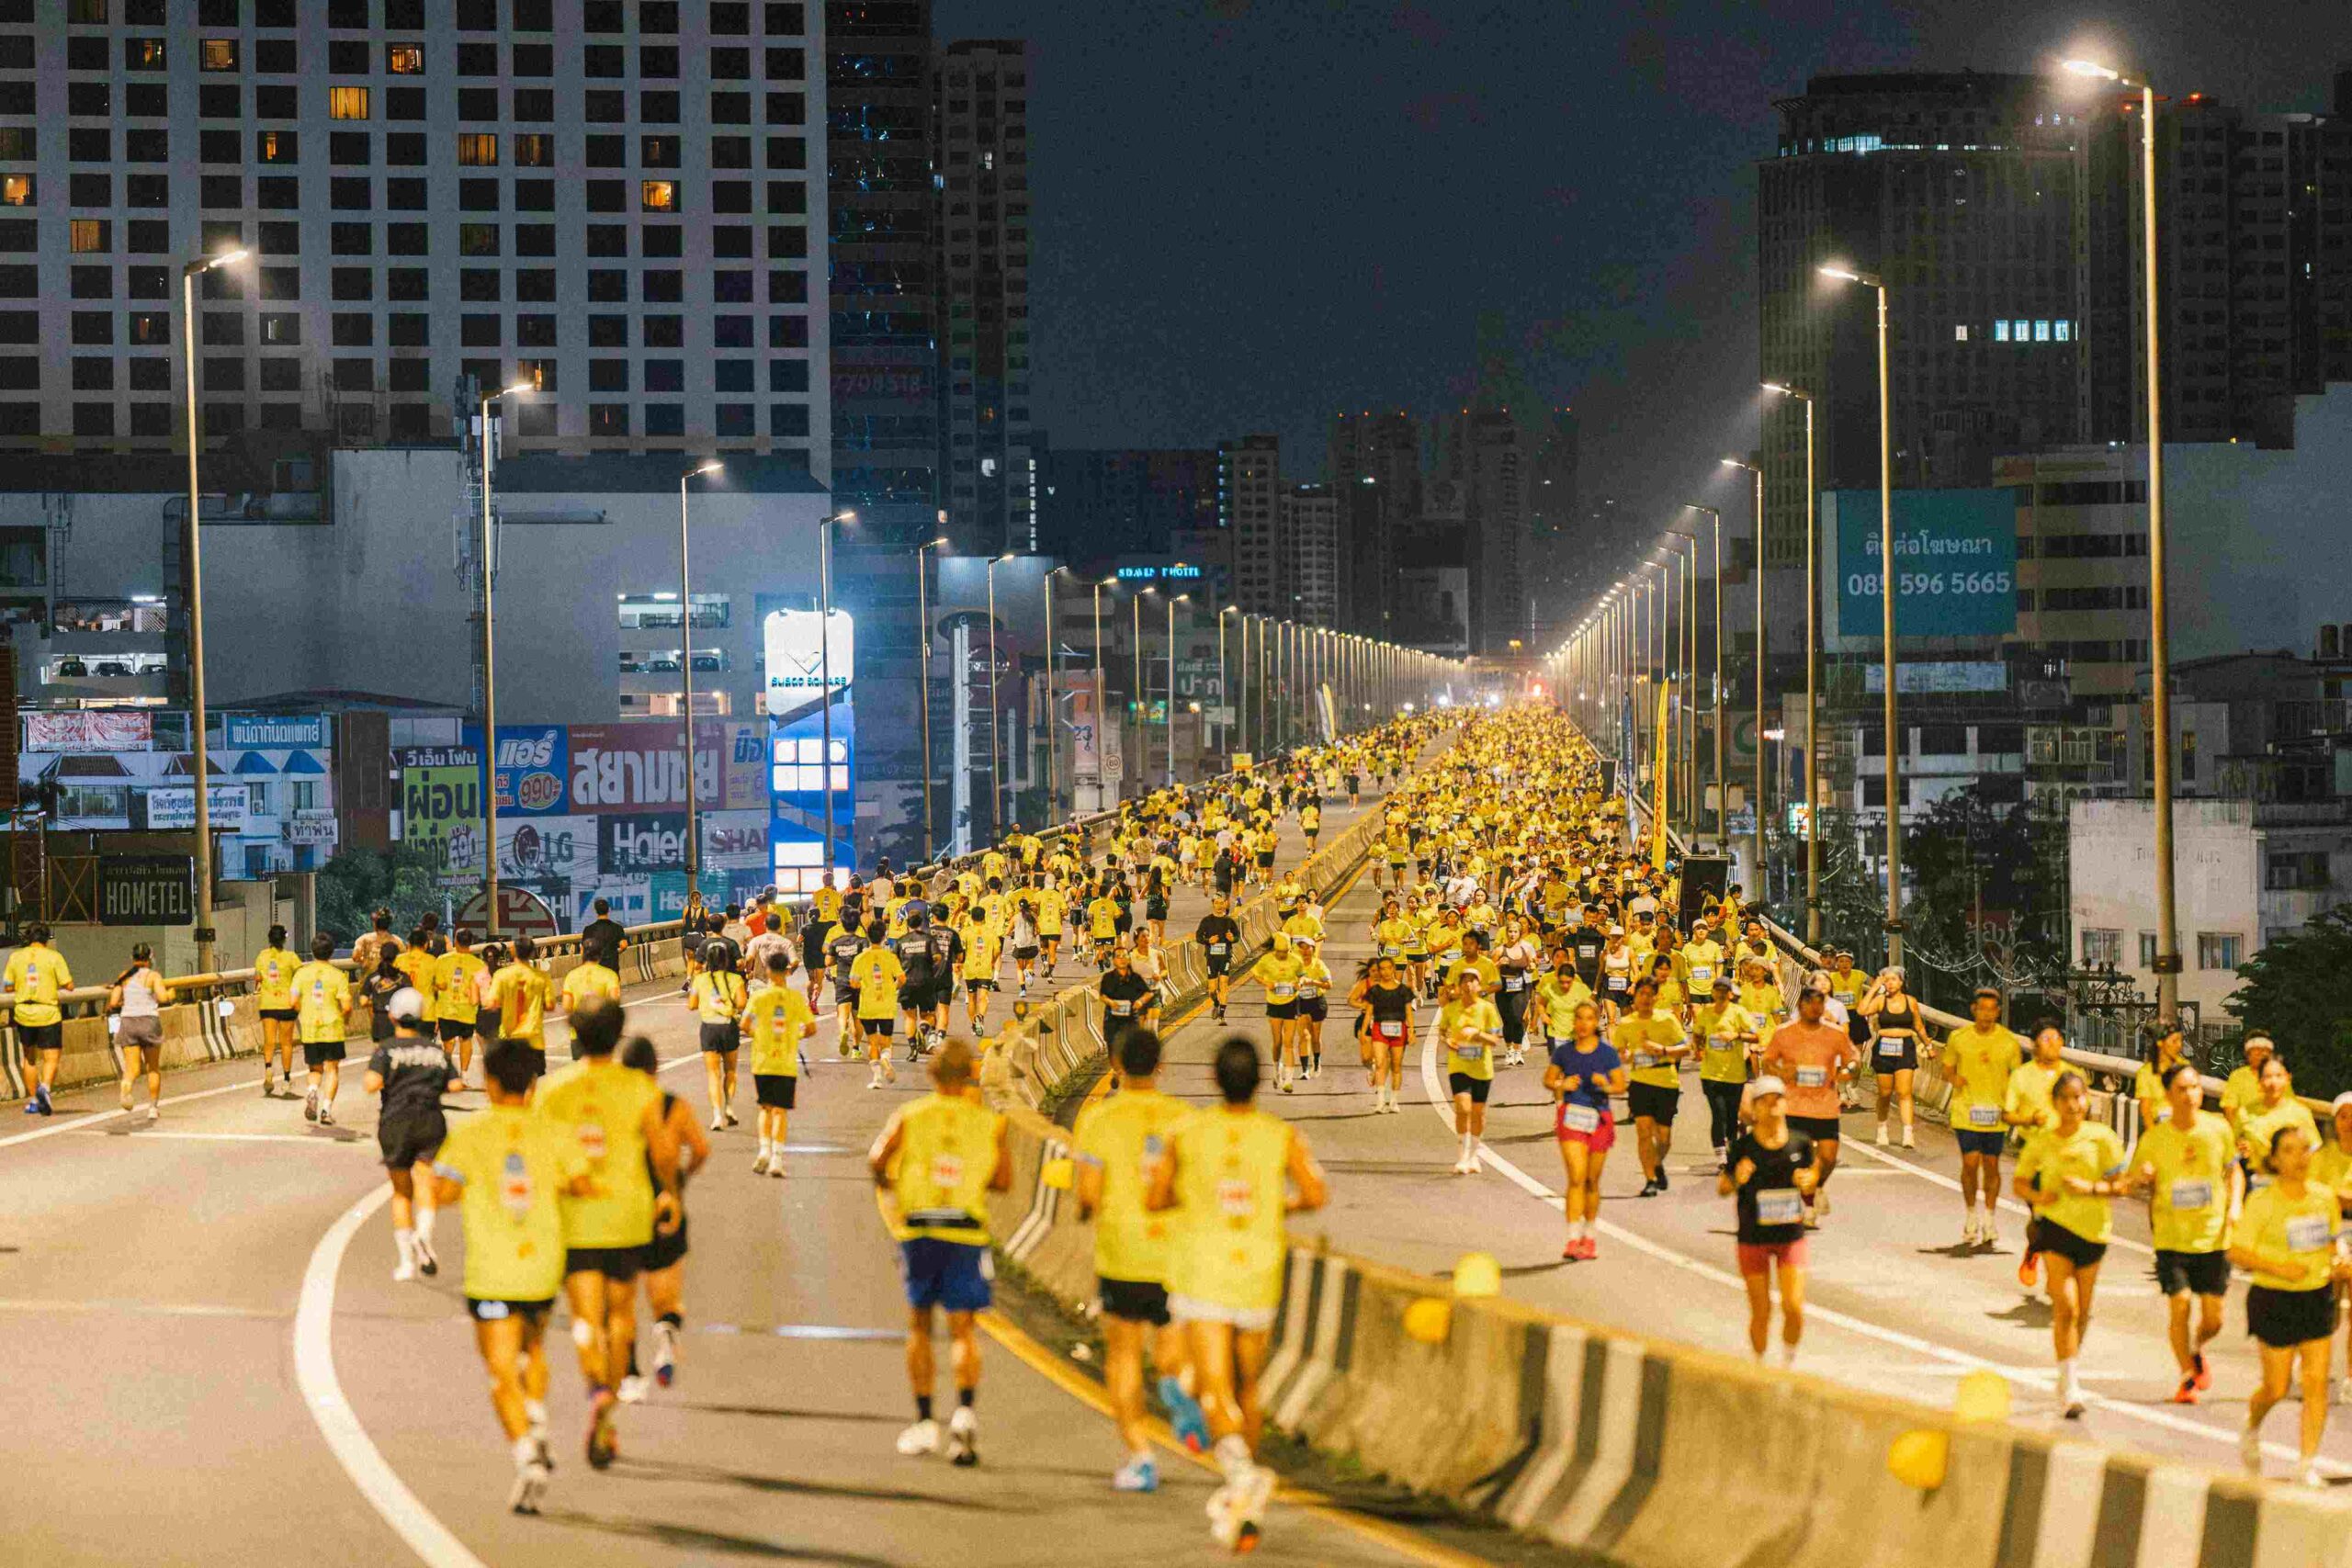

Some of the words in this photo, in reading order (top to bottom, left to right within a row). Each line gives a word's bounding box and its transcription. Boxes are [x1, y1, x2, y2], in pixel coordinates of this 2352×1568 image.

[1865, 530, 1993, 556] ติต่อโฆษณา
[1900, 572, 1945, 596] 596
[1951, 571, 2011, 594] 5665
[497, 730, 558, 768] แอร์
[572, 734, 718, 806] สยามชัย
[407, 770, 477, 819] ผ่อน
[544, 831, 573, 863] LG
[614, 821, 687, 864] Haier
[709, 828, 769, 853] SHA
[106, 882, 188, 915] HOMETEL
[660, 890, 721, 911] Hisse
